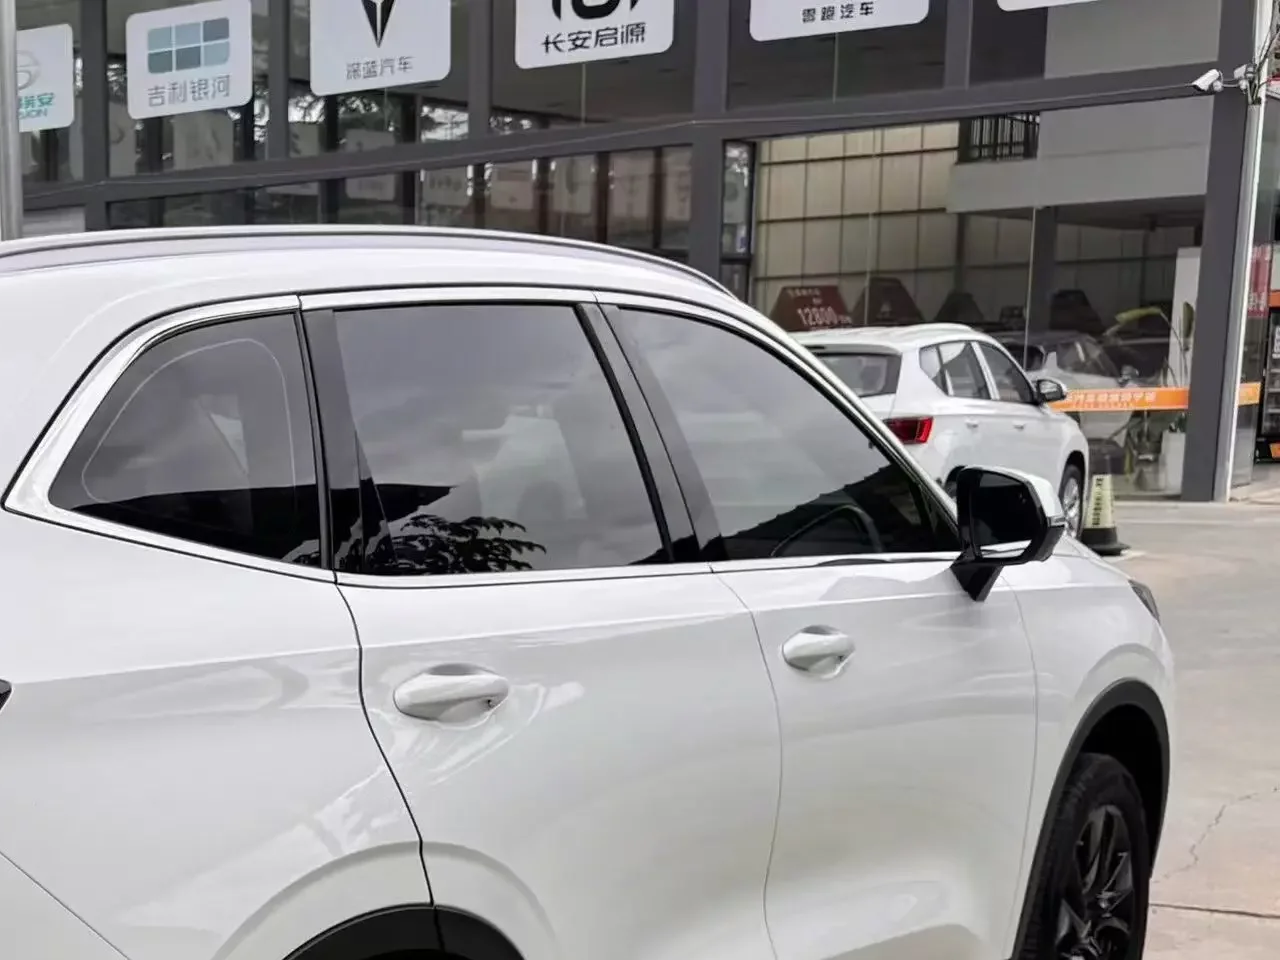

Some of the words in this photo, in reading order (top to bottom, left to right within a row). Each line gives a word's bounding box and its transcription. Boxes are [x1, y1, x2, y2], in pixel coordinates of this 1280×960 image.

[542, 22, 646, 54] 长安启源
[346, 55, 416, 80] 深蓝汽车
[147, 74, 230, 107] 吉利银河
